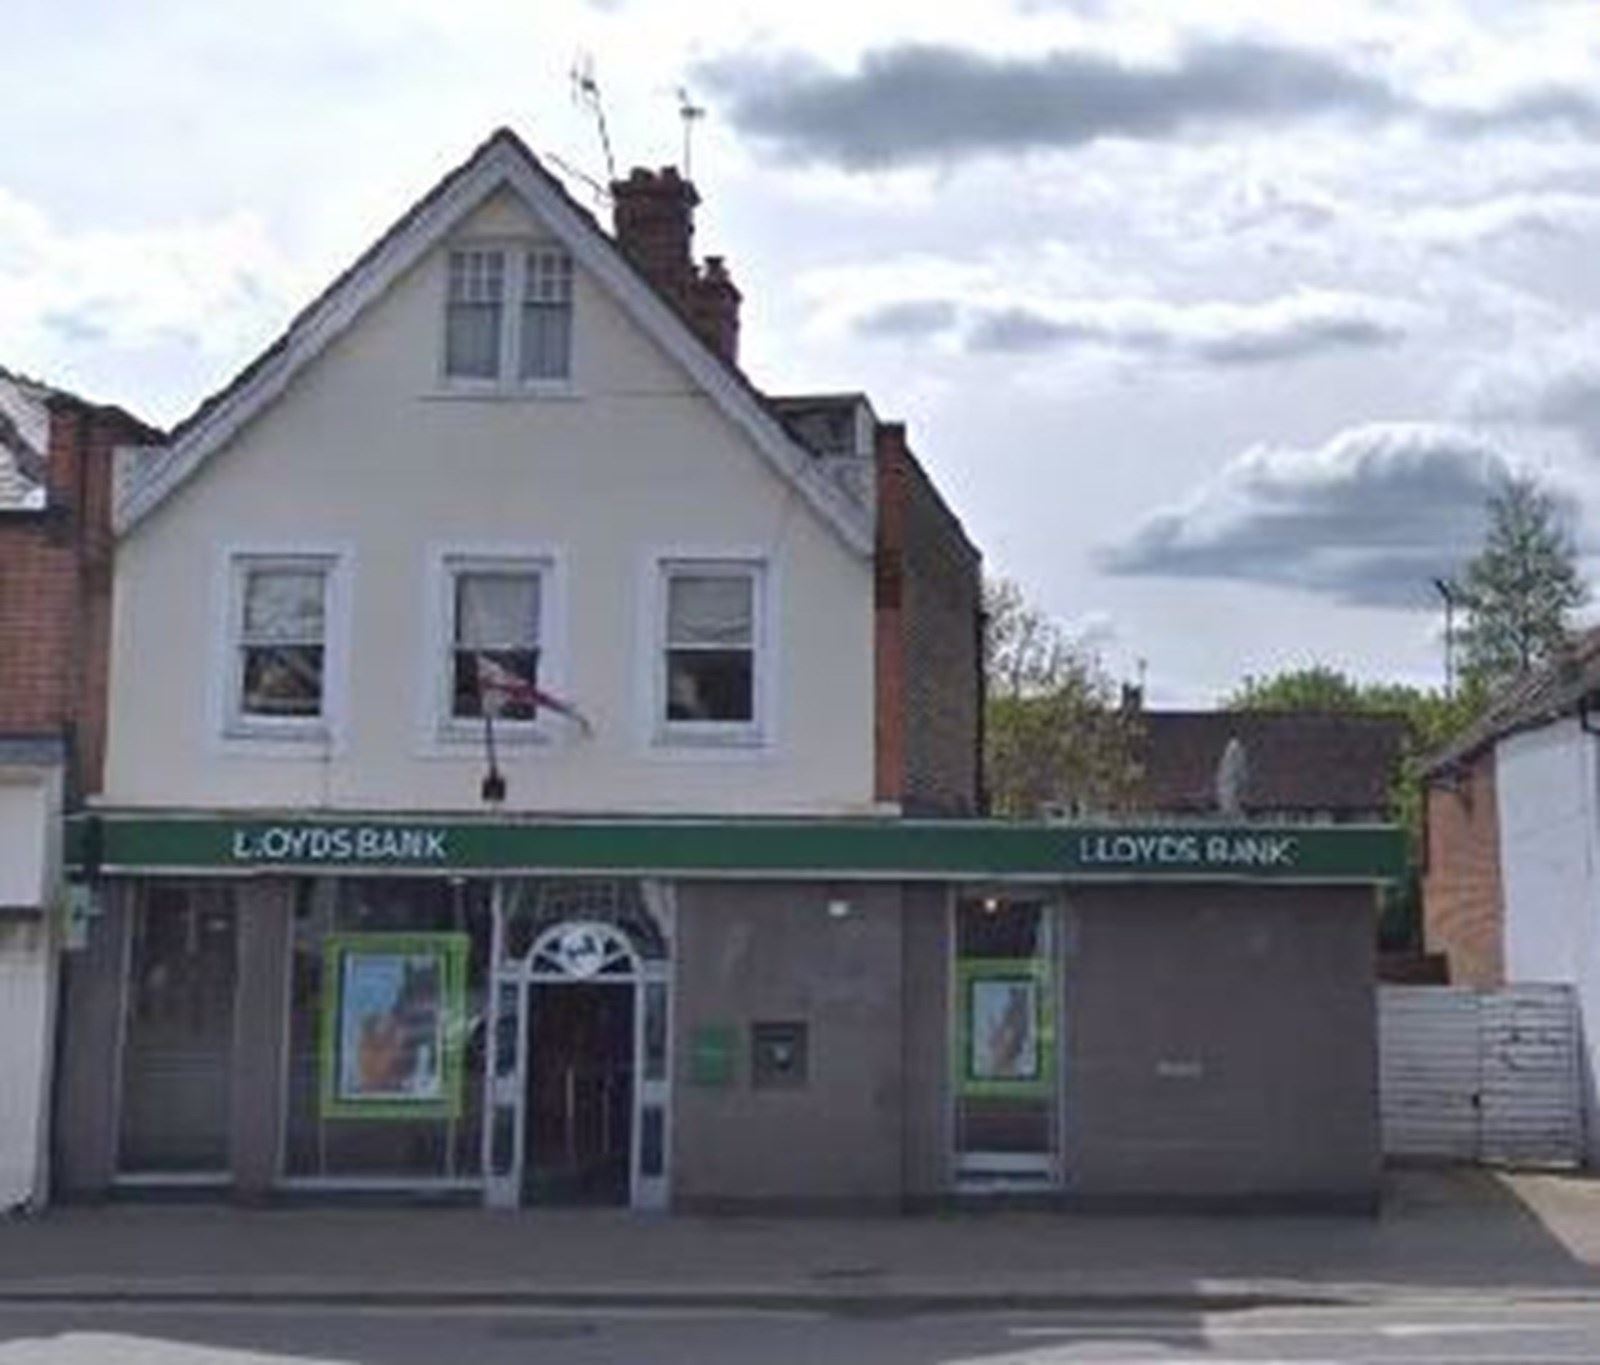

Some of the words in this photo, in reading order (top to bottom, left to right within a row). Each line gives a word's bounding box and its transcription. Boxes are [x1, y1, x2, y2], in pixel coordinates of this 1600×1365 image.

[233, 828, 352, 858] LOYDS
[357, 828, 448, 858] BANK
[1080, 835, 1200, 863] LLOYDS
[1206, 836, 1298, 865] BANK
